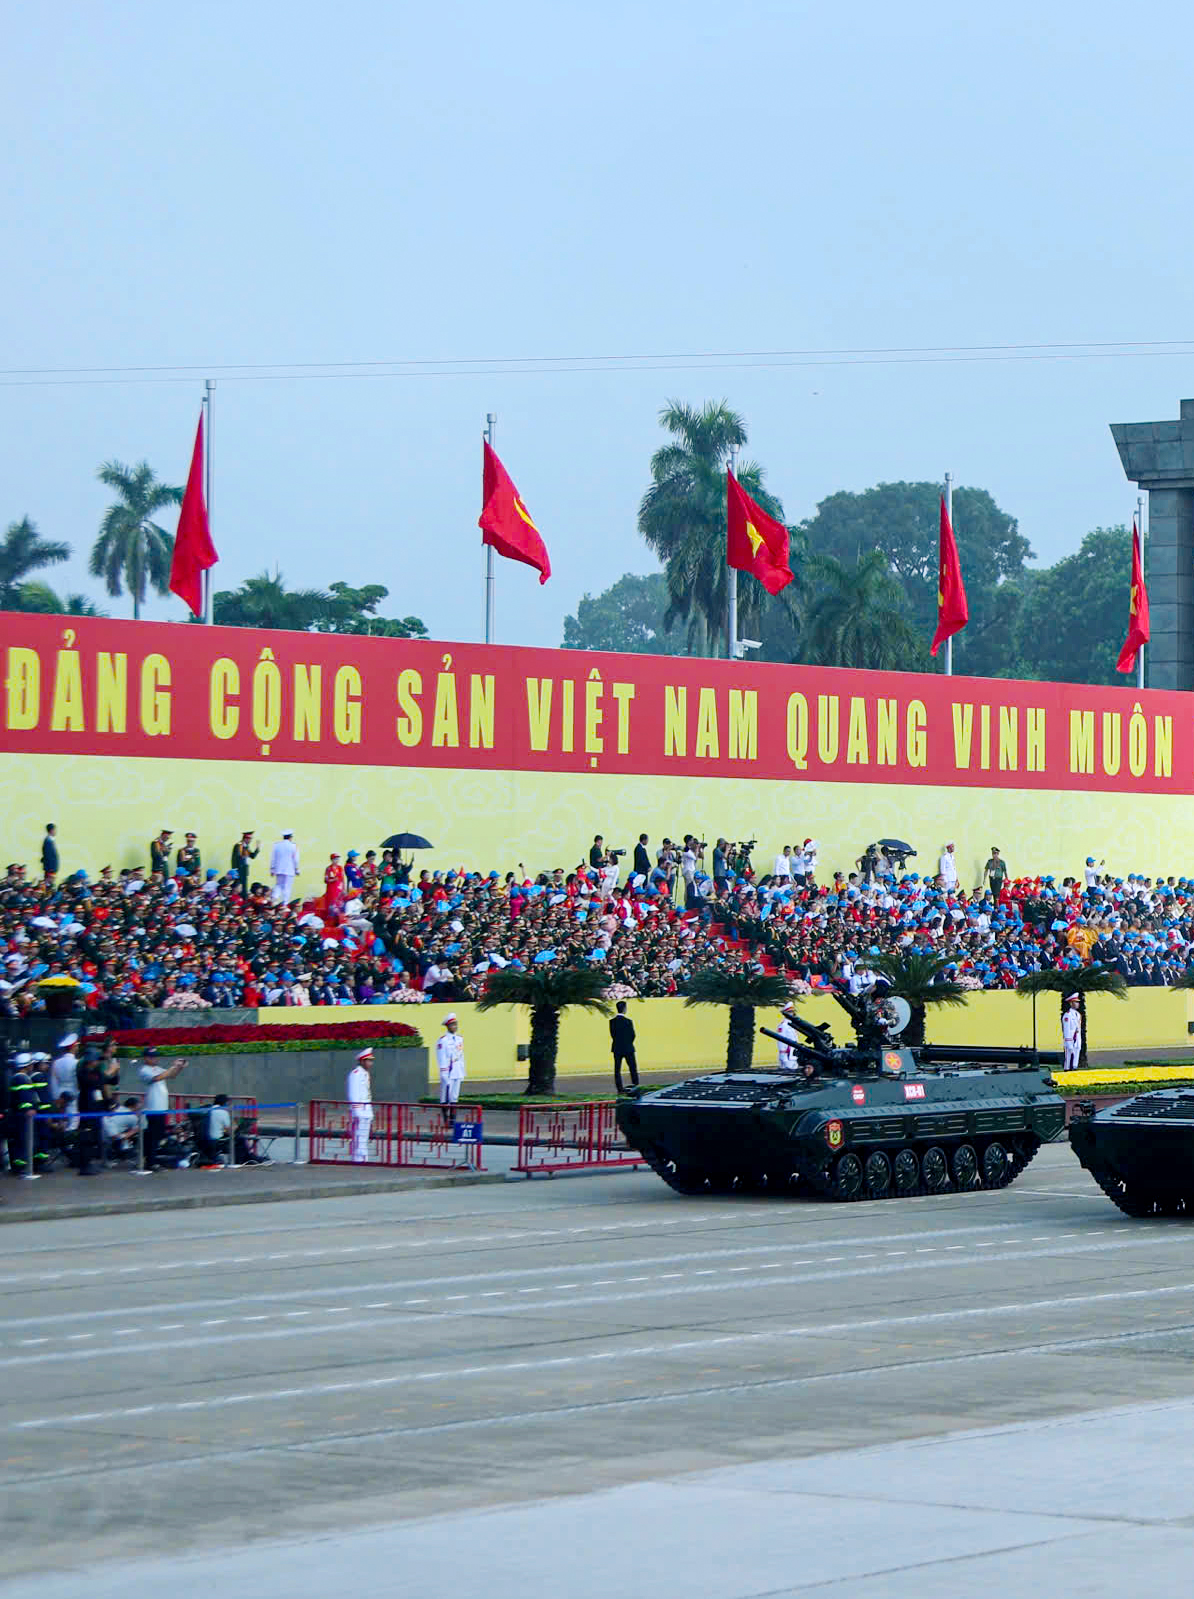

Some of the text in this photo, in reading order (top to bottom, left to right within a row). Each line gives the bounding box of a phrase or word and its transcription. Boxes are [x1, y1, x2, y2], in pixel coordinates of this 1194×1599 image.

[5, 629, 172, 736] ĐẢNG
[210, 647, 363, 756] CỘNG
[397, 653, 495, 750] SẢN
[526, 667, 635, 768] VIỆT
[664, 685, 758, 760] NAM
[786, 692, 927, 770] QUANG
[951, 702, 1046, 773] VINH
[1069, 702, 1173, 778] MUÔN
